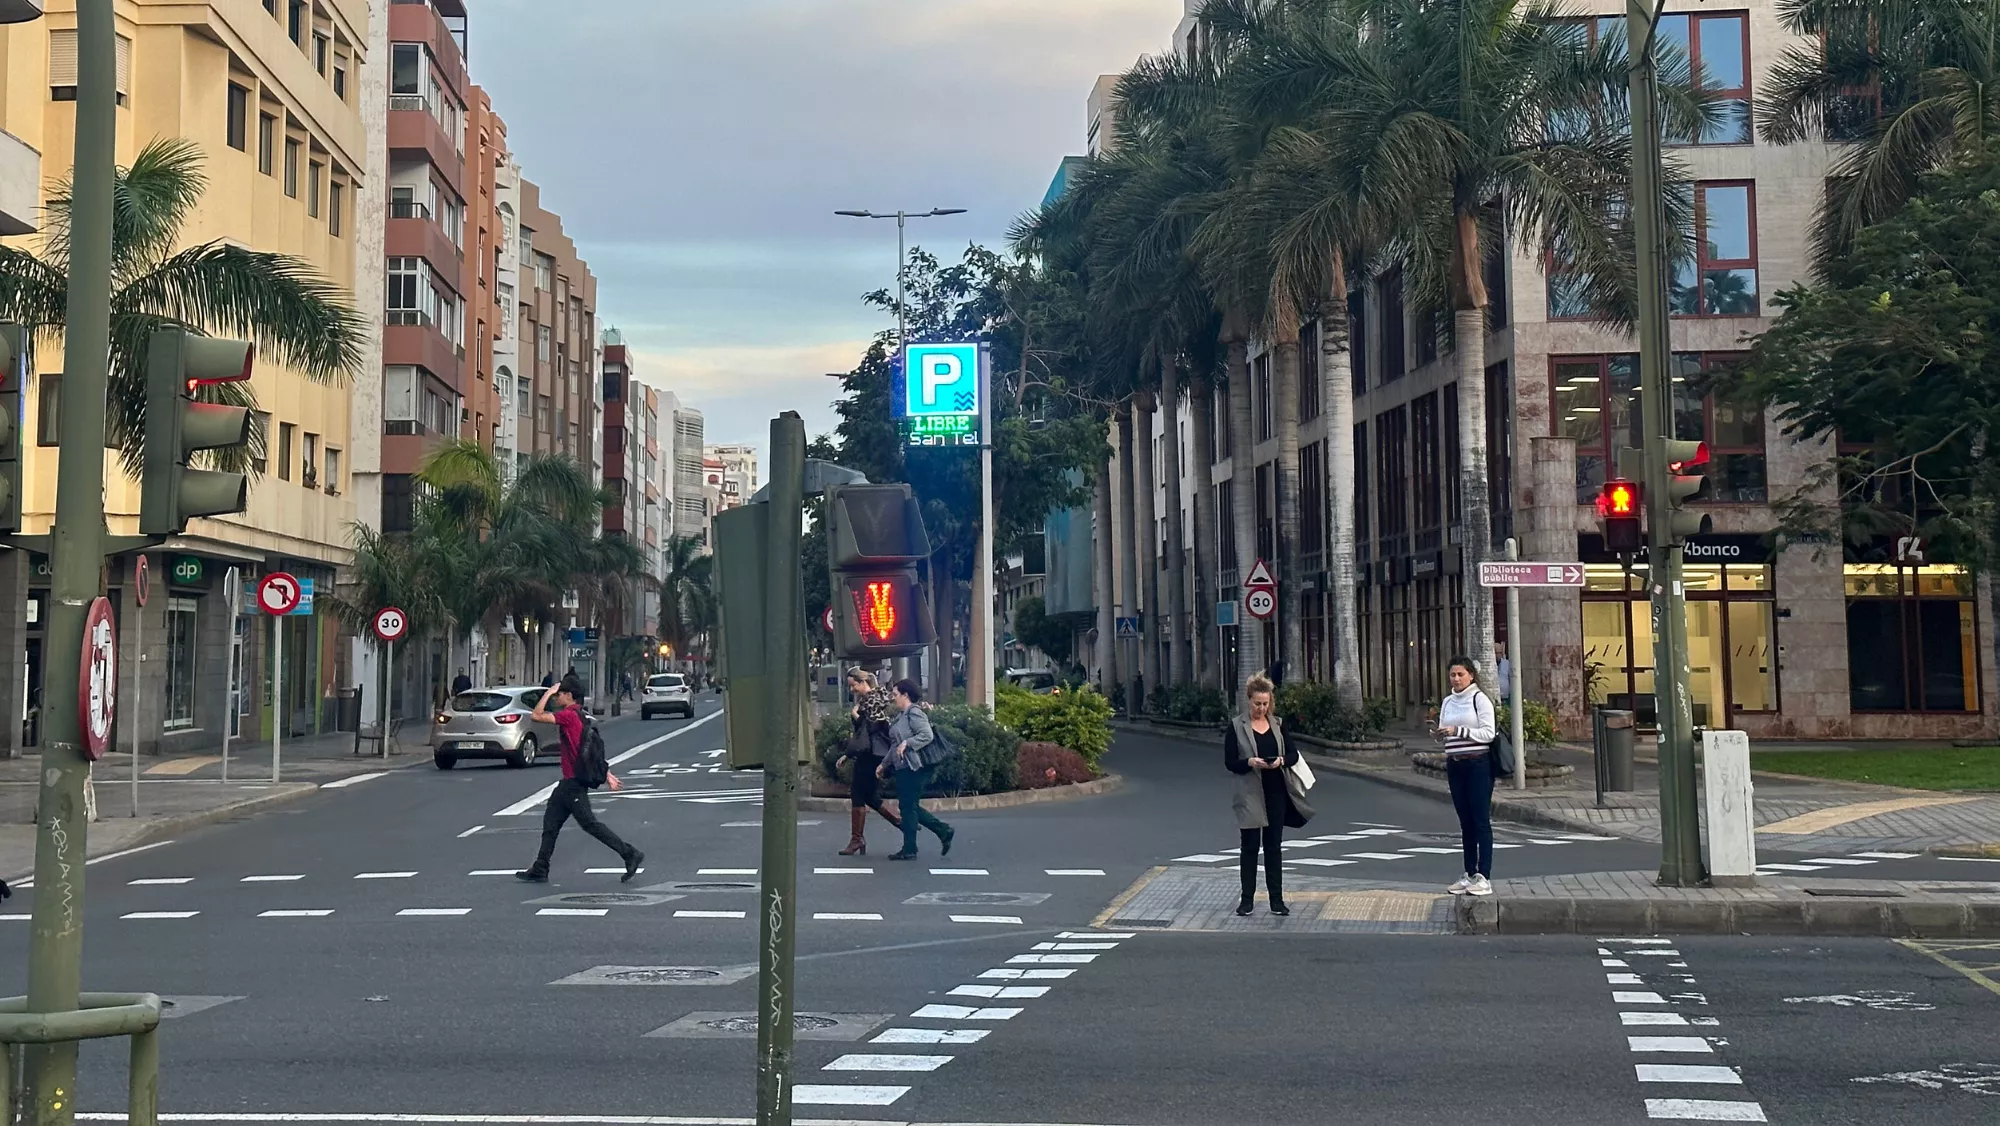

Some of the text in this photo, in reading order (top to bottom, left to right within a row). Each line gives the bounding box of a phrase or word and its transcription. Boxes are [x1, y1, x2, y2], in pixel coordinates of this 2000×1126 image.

[922, 353, 962, 406] P
[914, 416, 969, 431] LIBRE
[909, 431, 979, 447] San Tel
[175, 563, 198, 579] dp
[1483, 566, 1532, 574] biblioteca
[1483, 573, 1519, 582] pública
[1253, 597, 1270, 608] 30
[381, 618, 400, 628] 30
